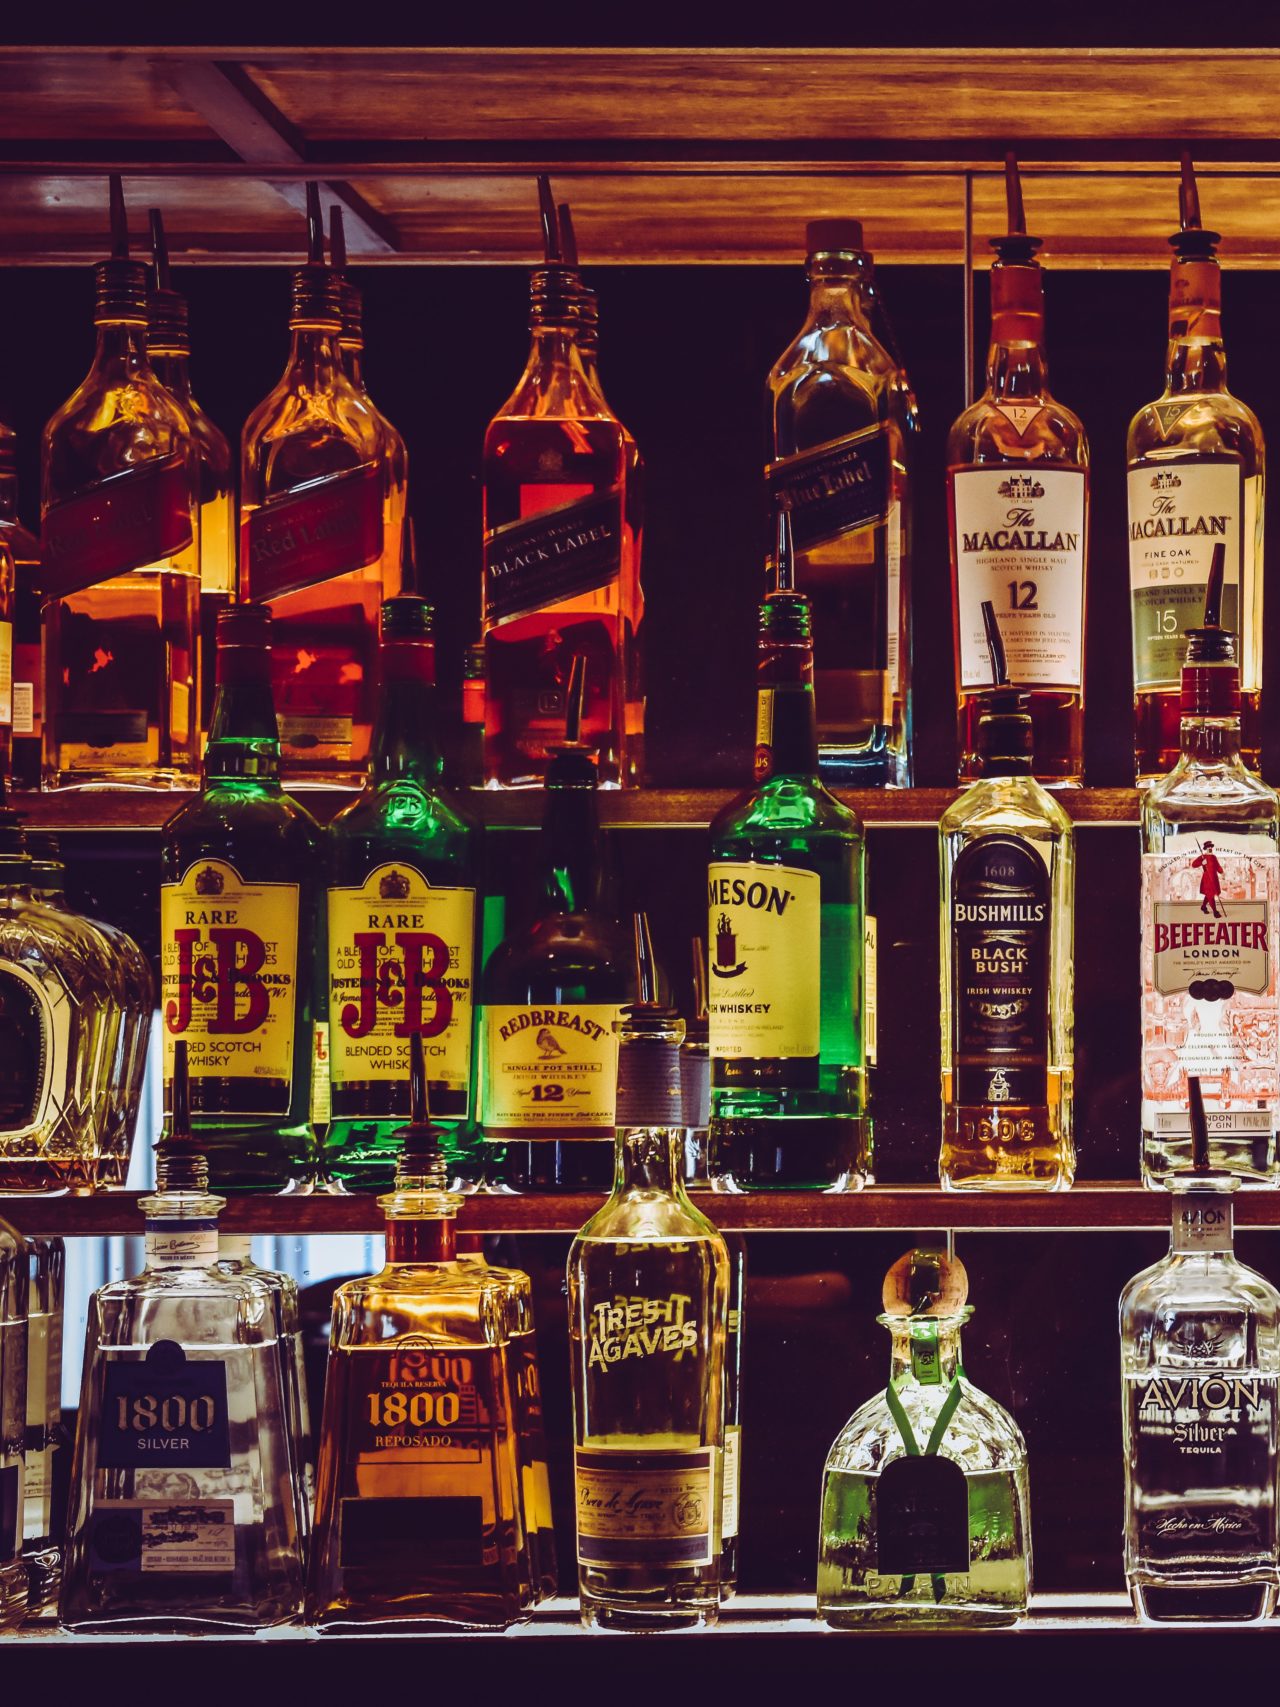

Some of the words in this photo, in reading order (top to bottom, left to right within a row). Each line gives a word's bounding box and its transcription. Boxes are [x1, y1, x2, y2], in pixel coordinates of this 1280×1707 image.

[1012, 408, 1028, 419] 12
[1165, 405, 1181, 417] 15
[1150, 496, 1176, 517] The
[1002, 507, 1035, 527] The
[490, 548, 549, 577] BLACK
[554, 523, 613, 554] LABEL
[962, 530, 1079, 553] MACALLAN
[1144, 551, 1167, 559] FINE
[1169, 549, 1191, 557] OAK
[1008, 581, 1038, 610] 12
[1156, 610, 1178, 634] 15
[984, 866, 1015, 877] 1608
[185, 910, 239, 925] RARE
[368, 915, 425, 928] RARE
[955, 903, 1047, 922] BUSHMILLS
[1155, 922, 1269, 953] BEEFEATER
[971, 948, 1028, 960] BLACK
[1184, 949, 1240, 958] LONDON
[337, 959, 355, 968] OLD
[976, 961, 1023, 973] BUSH
[166, 928, 270, 1034] J&B
[342, 932, 454, 1038] J&B
[967, 987, 990, 995] IRISH
[993, 987, 1033, 995] WHISKEY
[720, 1003, 771, 1014] WHISKEY
[499, 1010, 605, 1042] REDBREAST
[209, 1042, 262, 1053] SCOTCH
[346, 1046, 393, 1056] BLENDED
[531, 1084, 564, 1102] 12
[593, 1300, 659, 1343] TRES
[588, 1320, 698, 1373] AGAVES
[1140, 1373, 1261, 1411] AVIÓN
[116, 1394, 215, 1433] 1800
[367, 1391, 460, 1427] 1800
[375, 1435, 451, 1448] REPOSADO
[1173, 1421, 1227, 1444] Silver
[137, 1438, 190, 1449] SILVER
